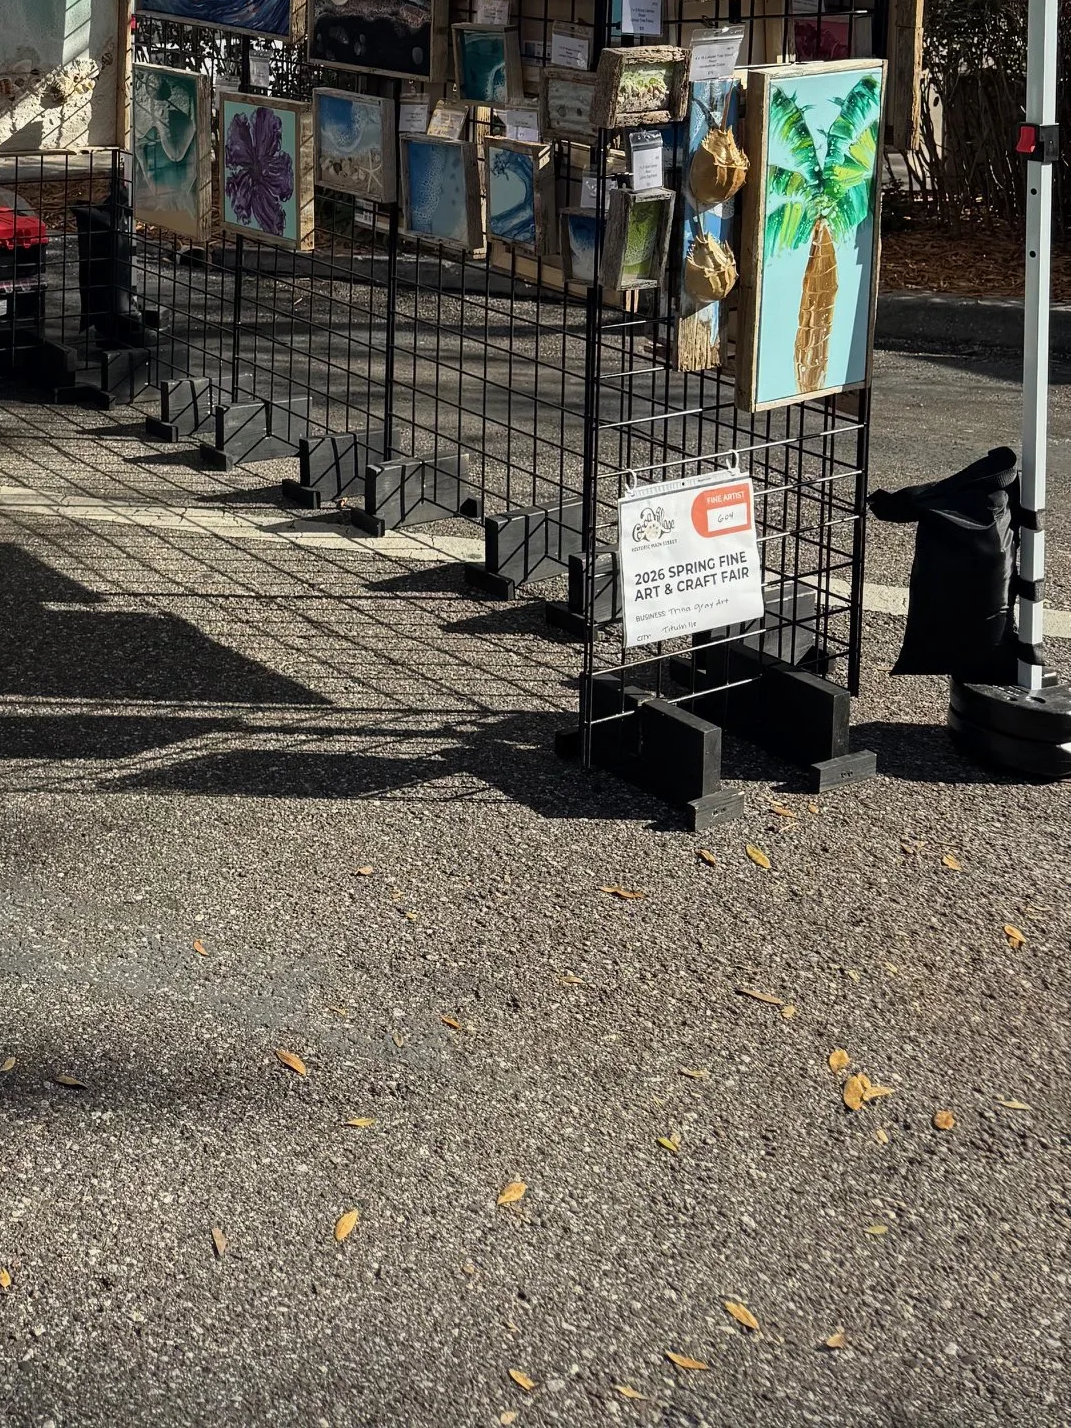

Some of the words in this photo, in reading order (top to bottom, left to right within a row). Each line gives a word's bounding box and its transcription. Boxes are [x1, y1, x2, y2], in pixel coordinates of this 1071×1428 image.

[706, 495, 722, 505] FINE
[723, 491, 745, 501] ARTIST
[634, 568, 666, 585] 2026
[668, 558, 716, 578] SPRING
[719, 551, 747, 568] FINE
[634, 585, 660, 602] ART
[664, 583, 673, 595] &
[677, 573, 718, 592] CRAFT
[721, 566, 749, 583] FAIR
